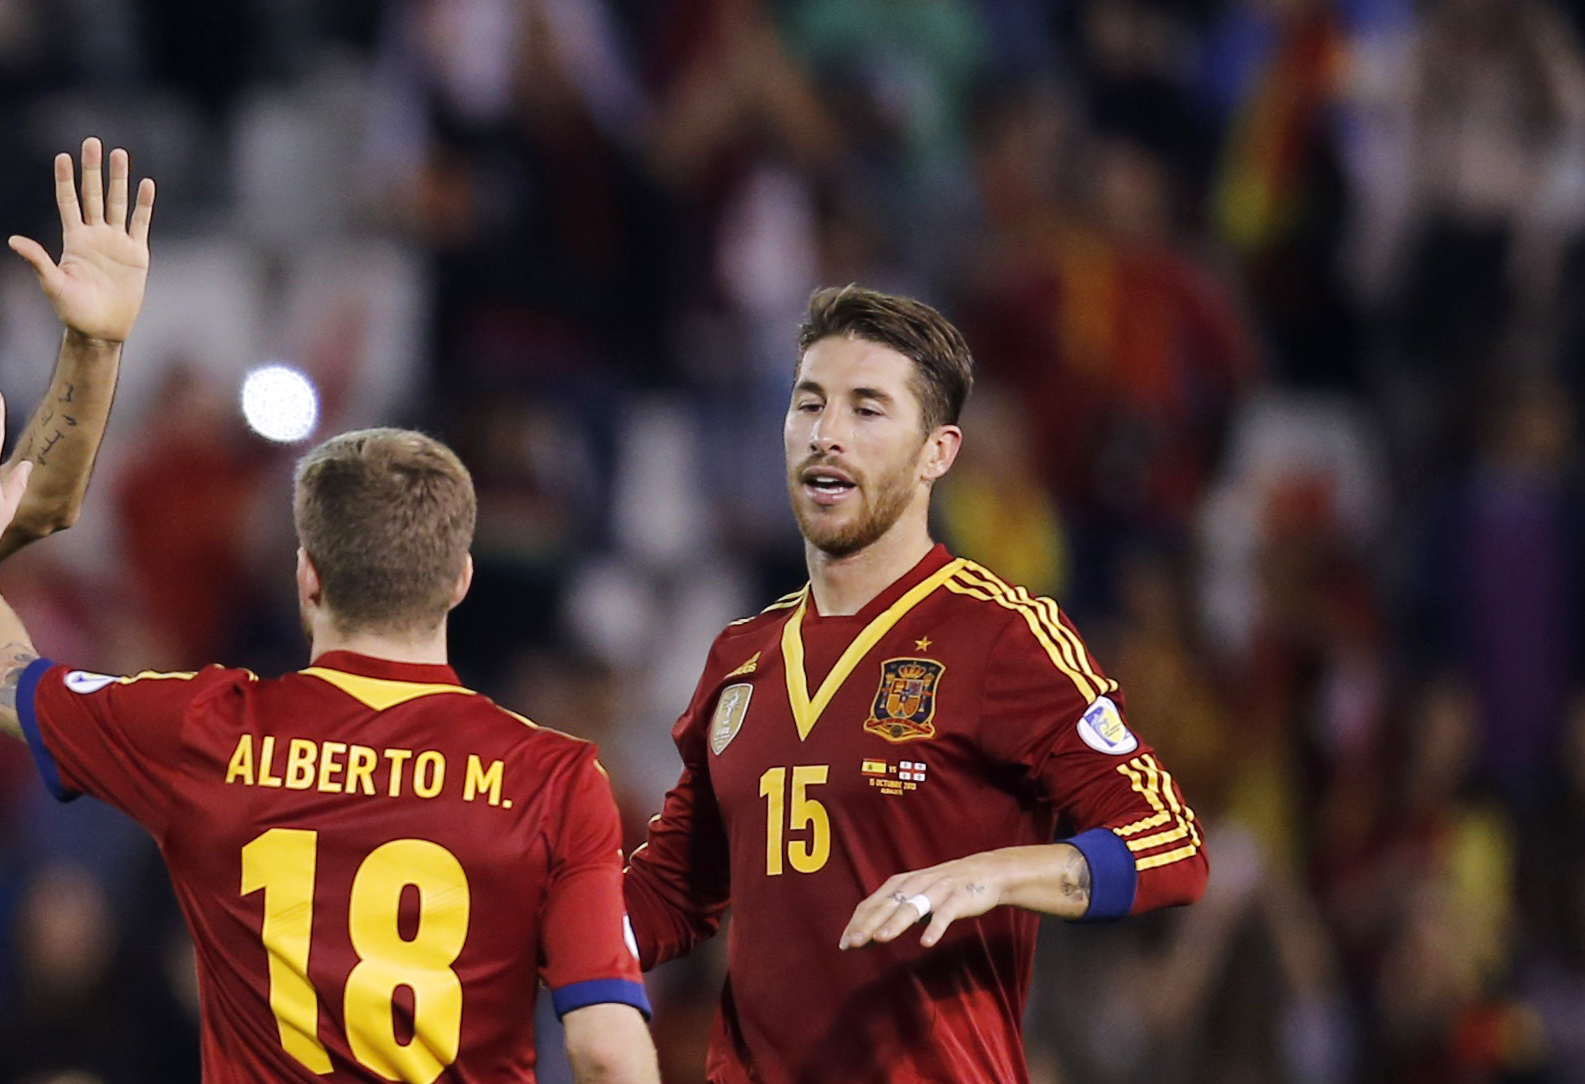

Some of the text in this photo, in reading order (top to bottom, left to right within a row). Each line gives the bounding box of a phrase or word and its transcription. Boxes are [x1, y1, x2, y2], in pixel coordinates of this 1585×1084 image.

[225, 734, 513, 809] ALBERTO M.
[759, 764, 831, 876] 15
